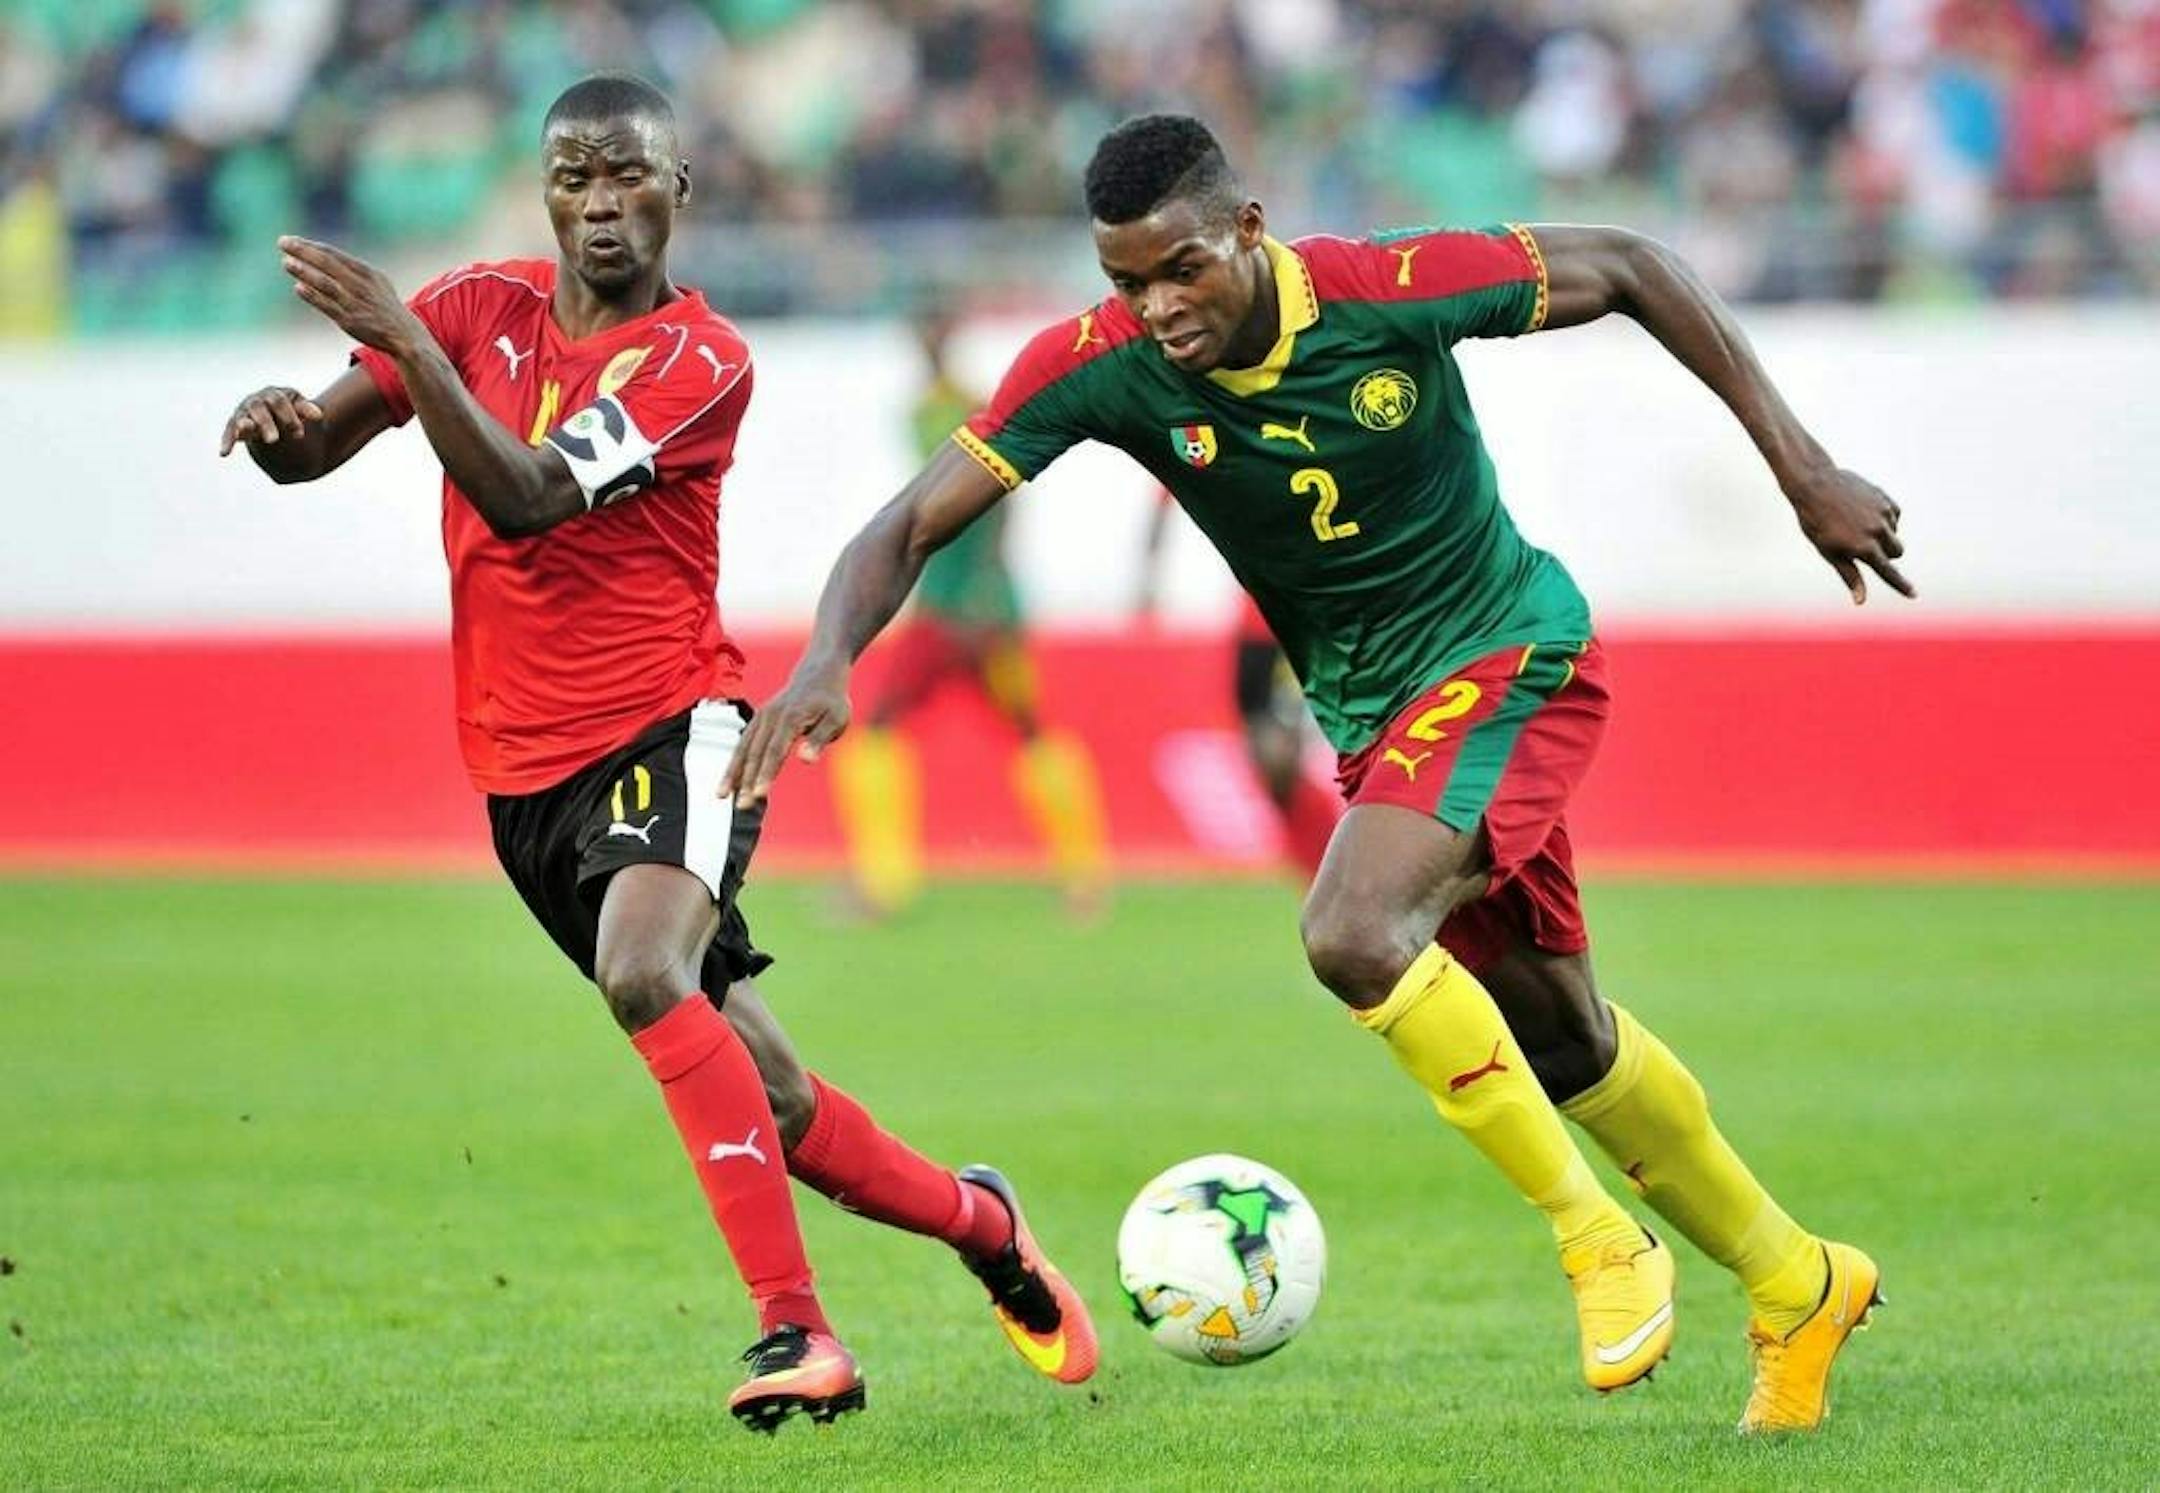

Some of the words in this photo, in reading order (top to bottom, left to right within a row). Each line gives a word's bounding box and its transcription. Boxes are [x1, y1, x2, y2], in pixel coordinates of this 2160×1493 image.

[1289, 468, 1360, 542] 2
[1405, 680, 1482, 742] 2
[610, 764, 652, 823] 11
